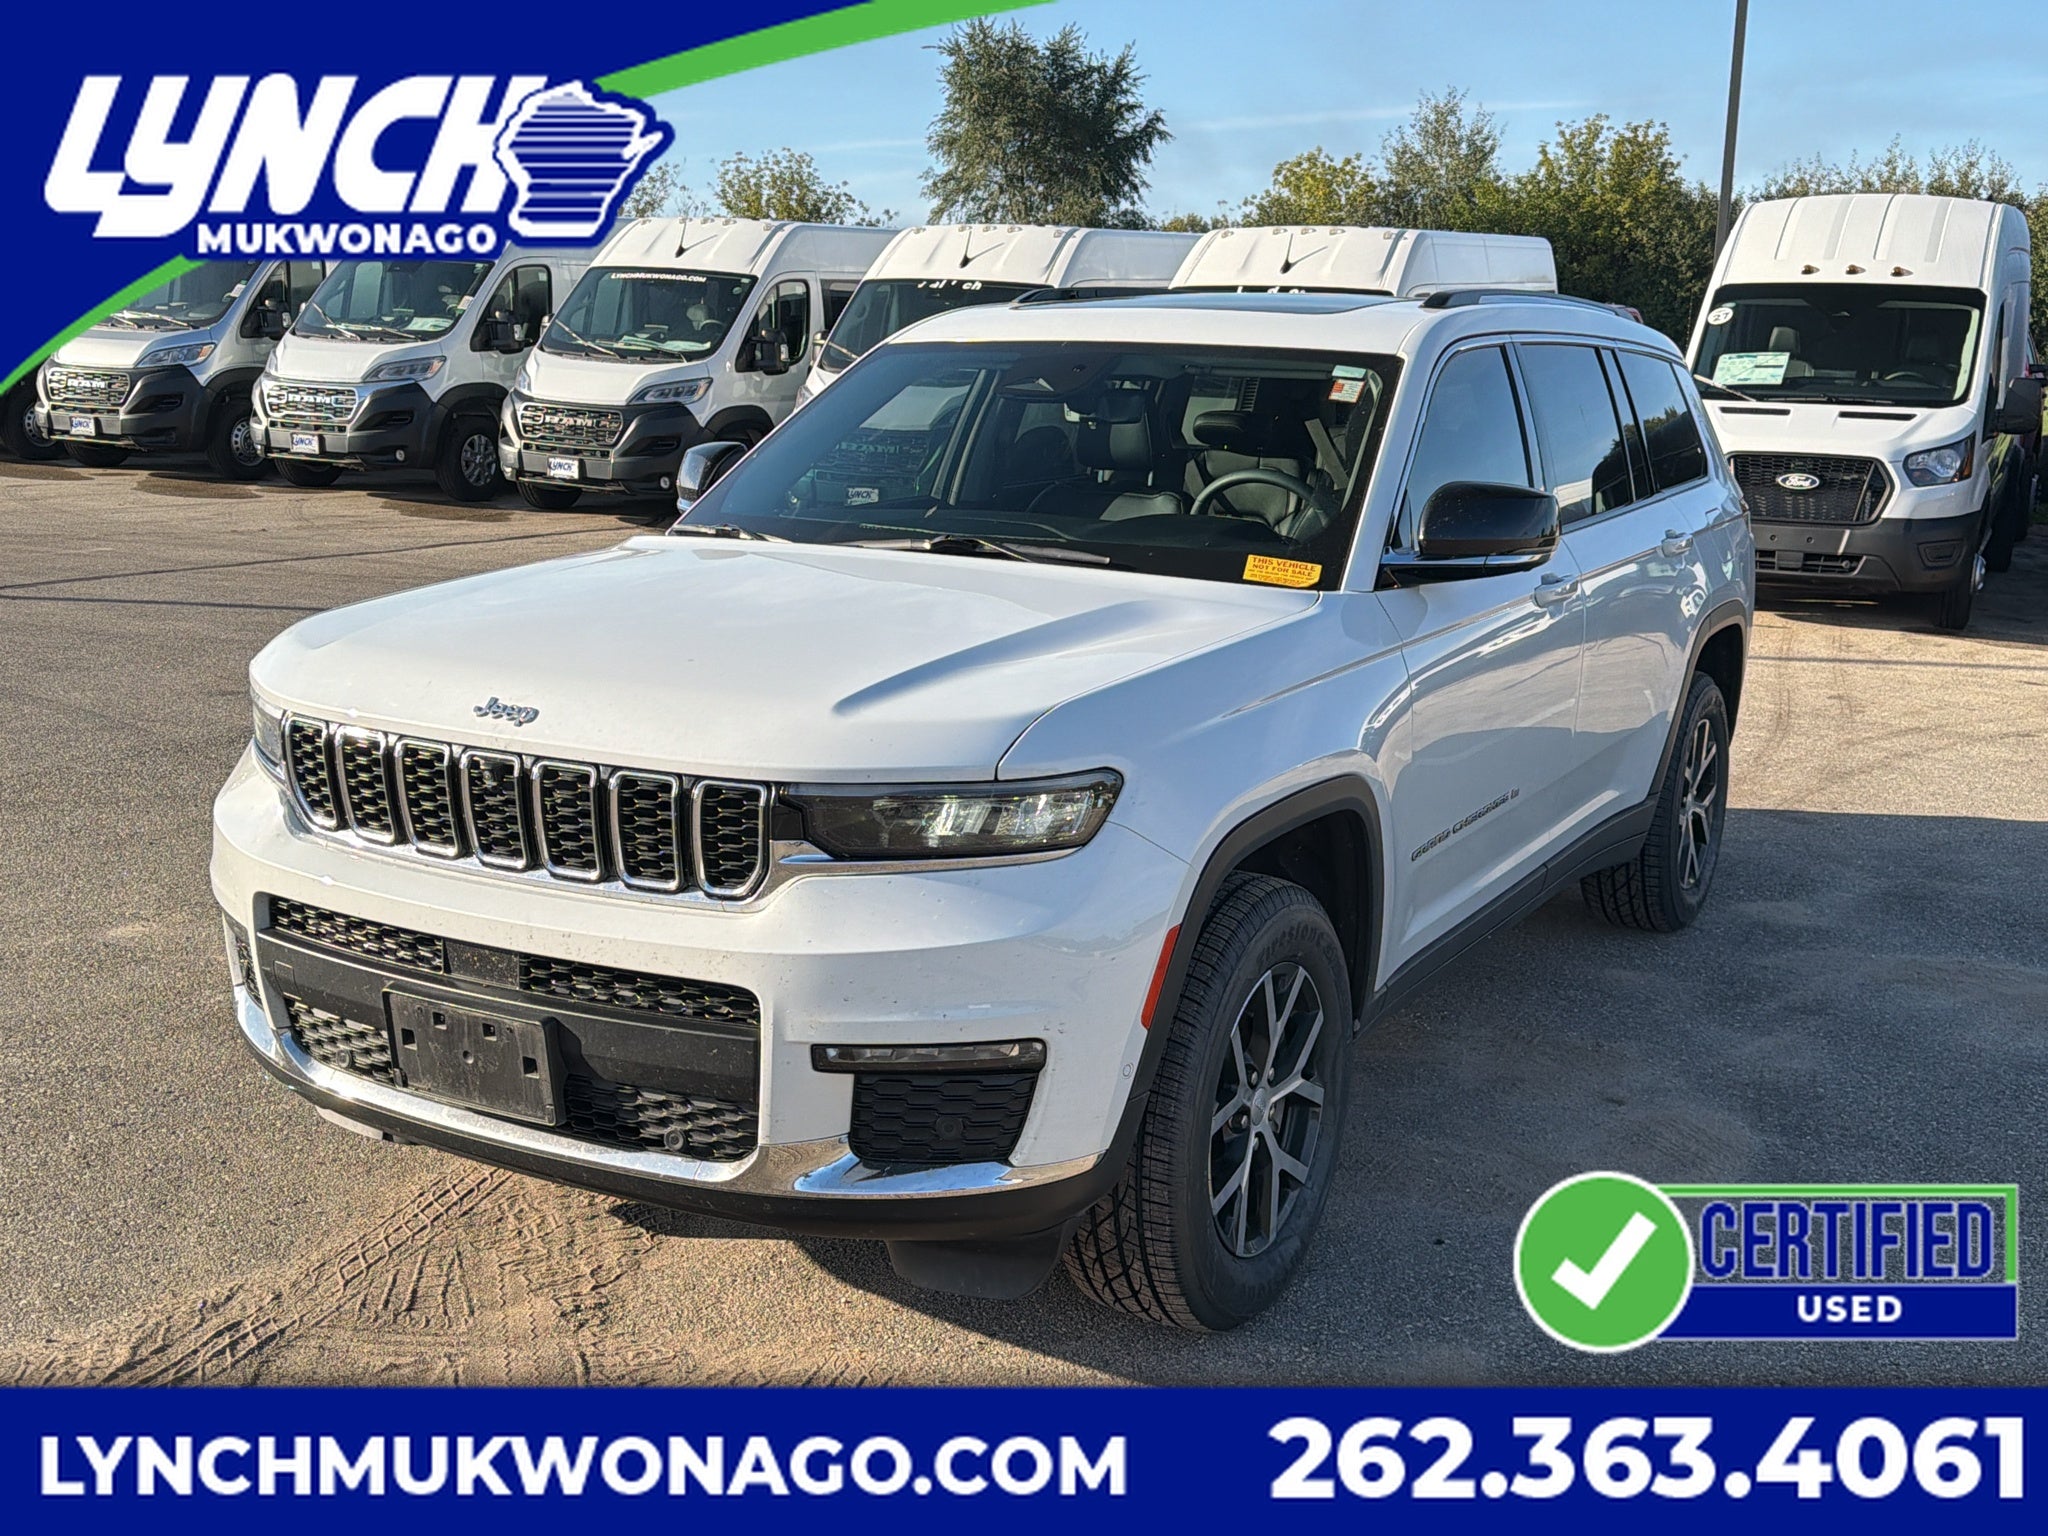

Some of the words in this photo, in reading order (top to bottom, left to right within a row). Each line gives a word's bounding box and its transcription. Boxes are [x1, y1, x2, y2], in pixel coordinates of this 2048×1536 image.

[544, 415, 593, 427] RAM
[1252, 557, 1274, 566] THIS
[1277, 560, 1317, 572] VEHICLE
[473, 696, 540, 728] Jeep
